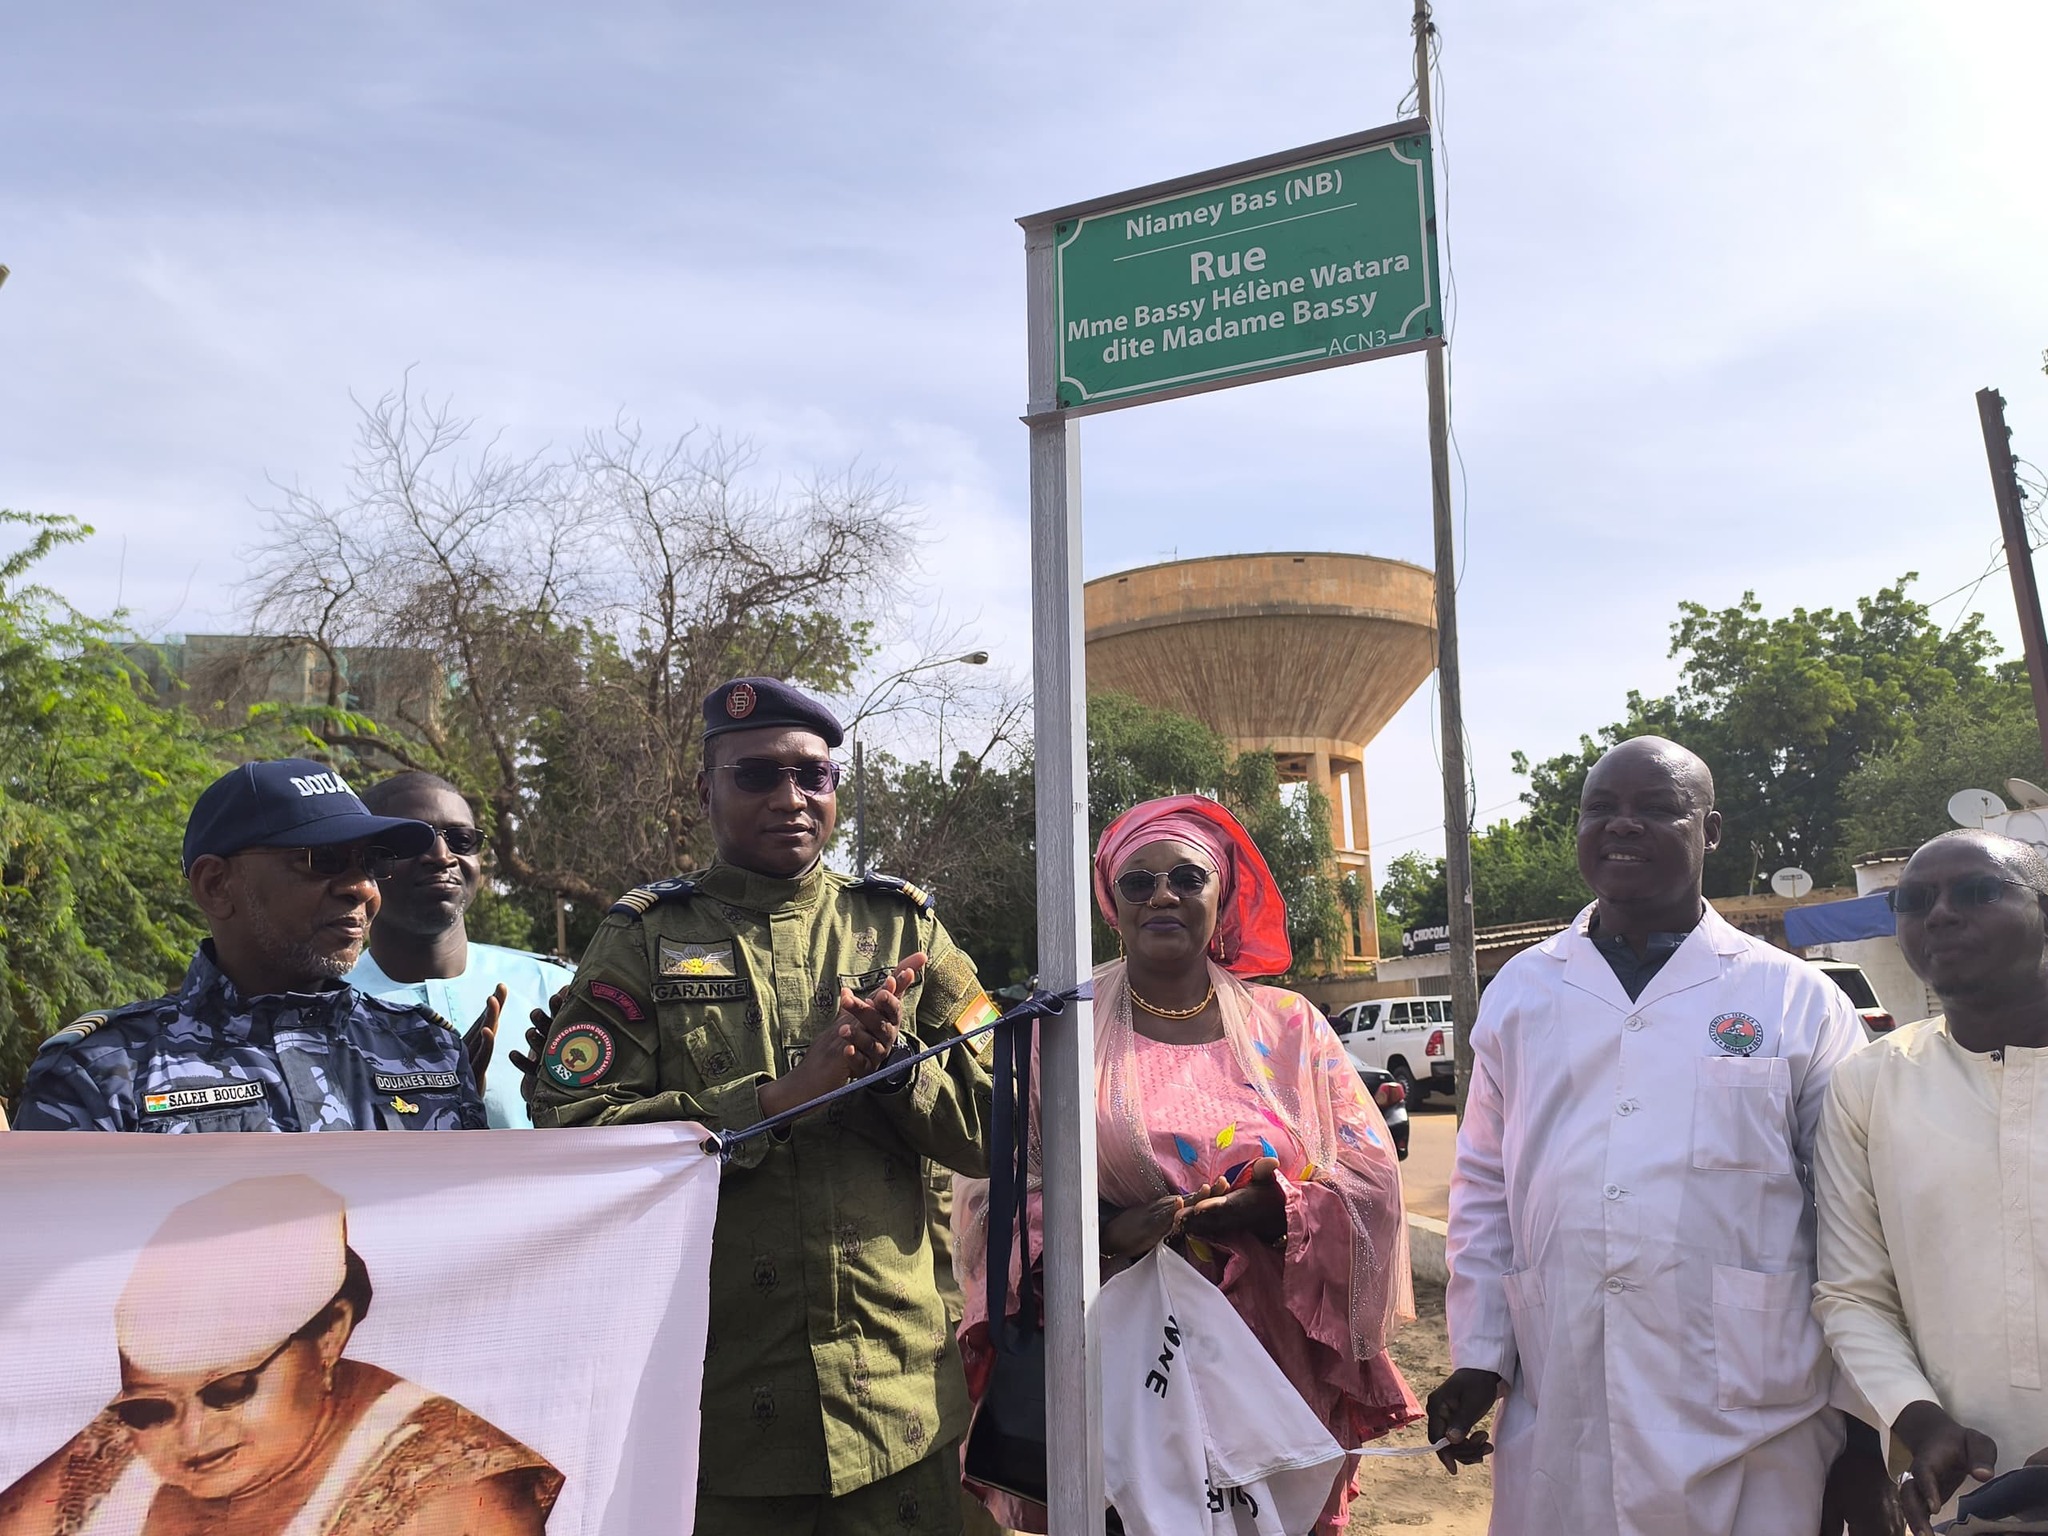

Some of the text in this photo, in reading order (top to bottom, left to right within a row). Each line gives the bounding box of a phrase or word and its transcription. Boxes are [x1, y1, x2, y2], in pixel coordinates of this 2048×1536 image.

[1126, 169, 1343, 240] Niamey Bas (NB)
[1190, 246, 1266, 285] Rue
[1068, 254, 1411, 341] Mme Bassy Hélène Watara
[1102, 290, 1378, 364] dite Madame Bassy
[1328, 329, 1388, 357] ACN3
[290, 771, 360, 799] DOUA
[1413, 925, 1450, 941] CHOCOLA
[655, 982, 745, 999] GARANKE
[377, 1074, 455, 1088] DOUANES NIGER
[168, 1084, 261, 1107] SALEH BOUCAR
